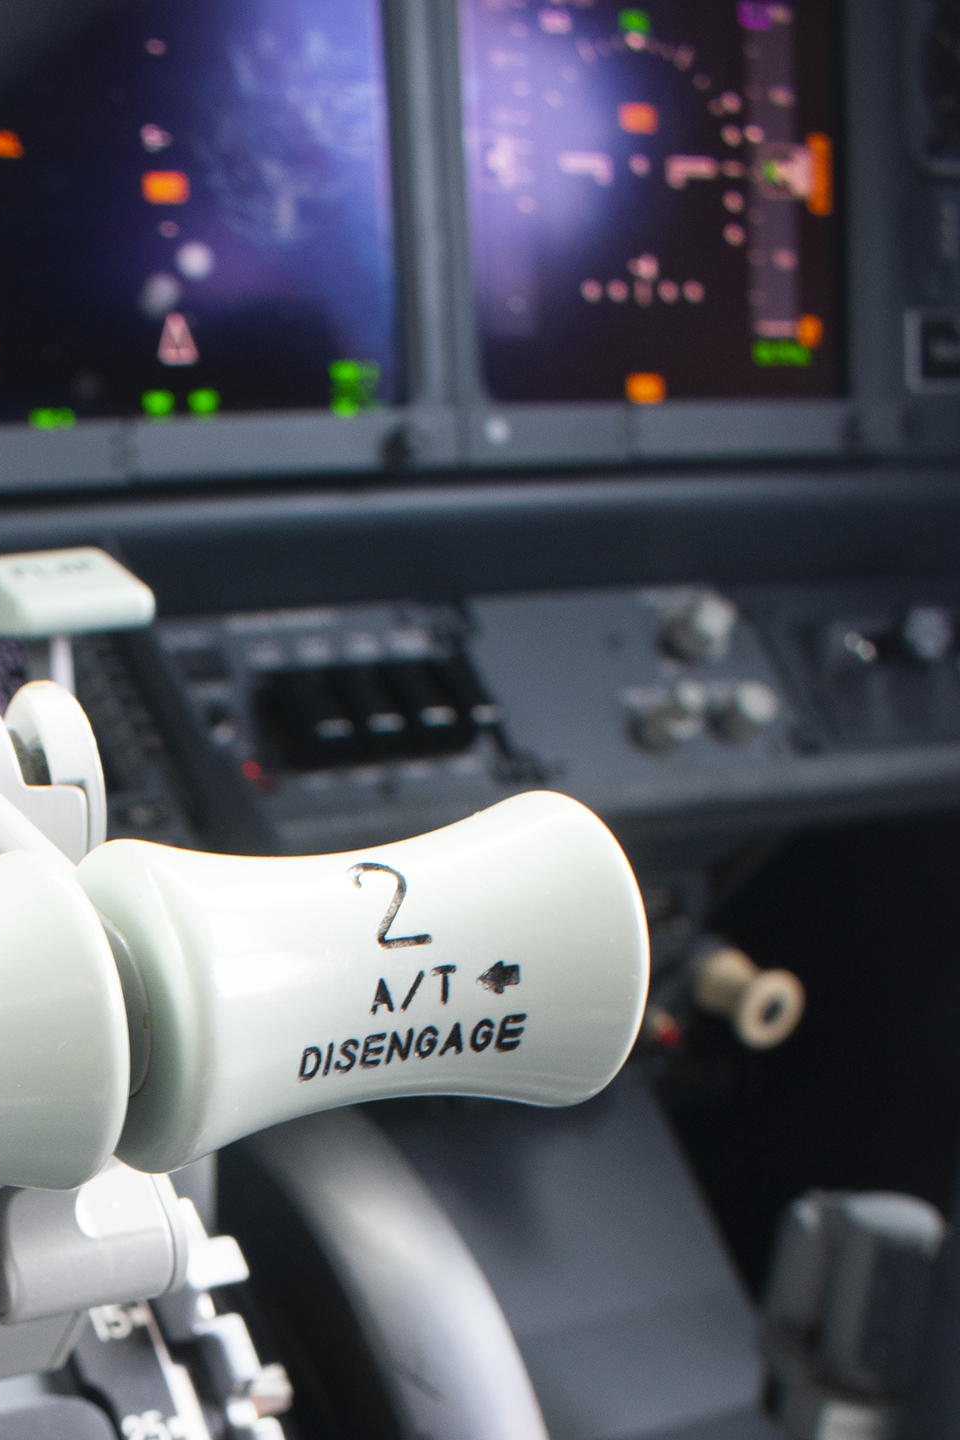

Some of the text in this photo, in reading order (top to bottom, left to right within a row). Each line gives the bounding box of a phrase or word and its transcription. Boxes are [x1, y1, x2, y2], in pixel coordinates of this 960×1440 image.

[346, 861, 433, 950] 2
[369, 964, 457, 1016] A/T
[297, 1012, 528, 1084] DISENGAGE
[88, 1303, 134, 1344] 15
